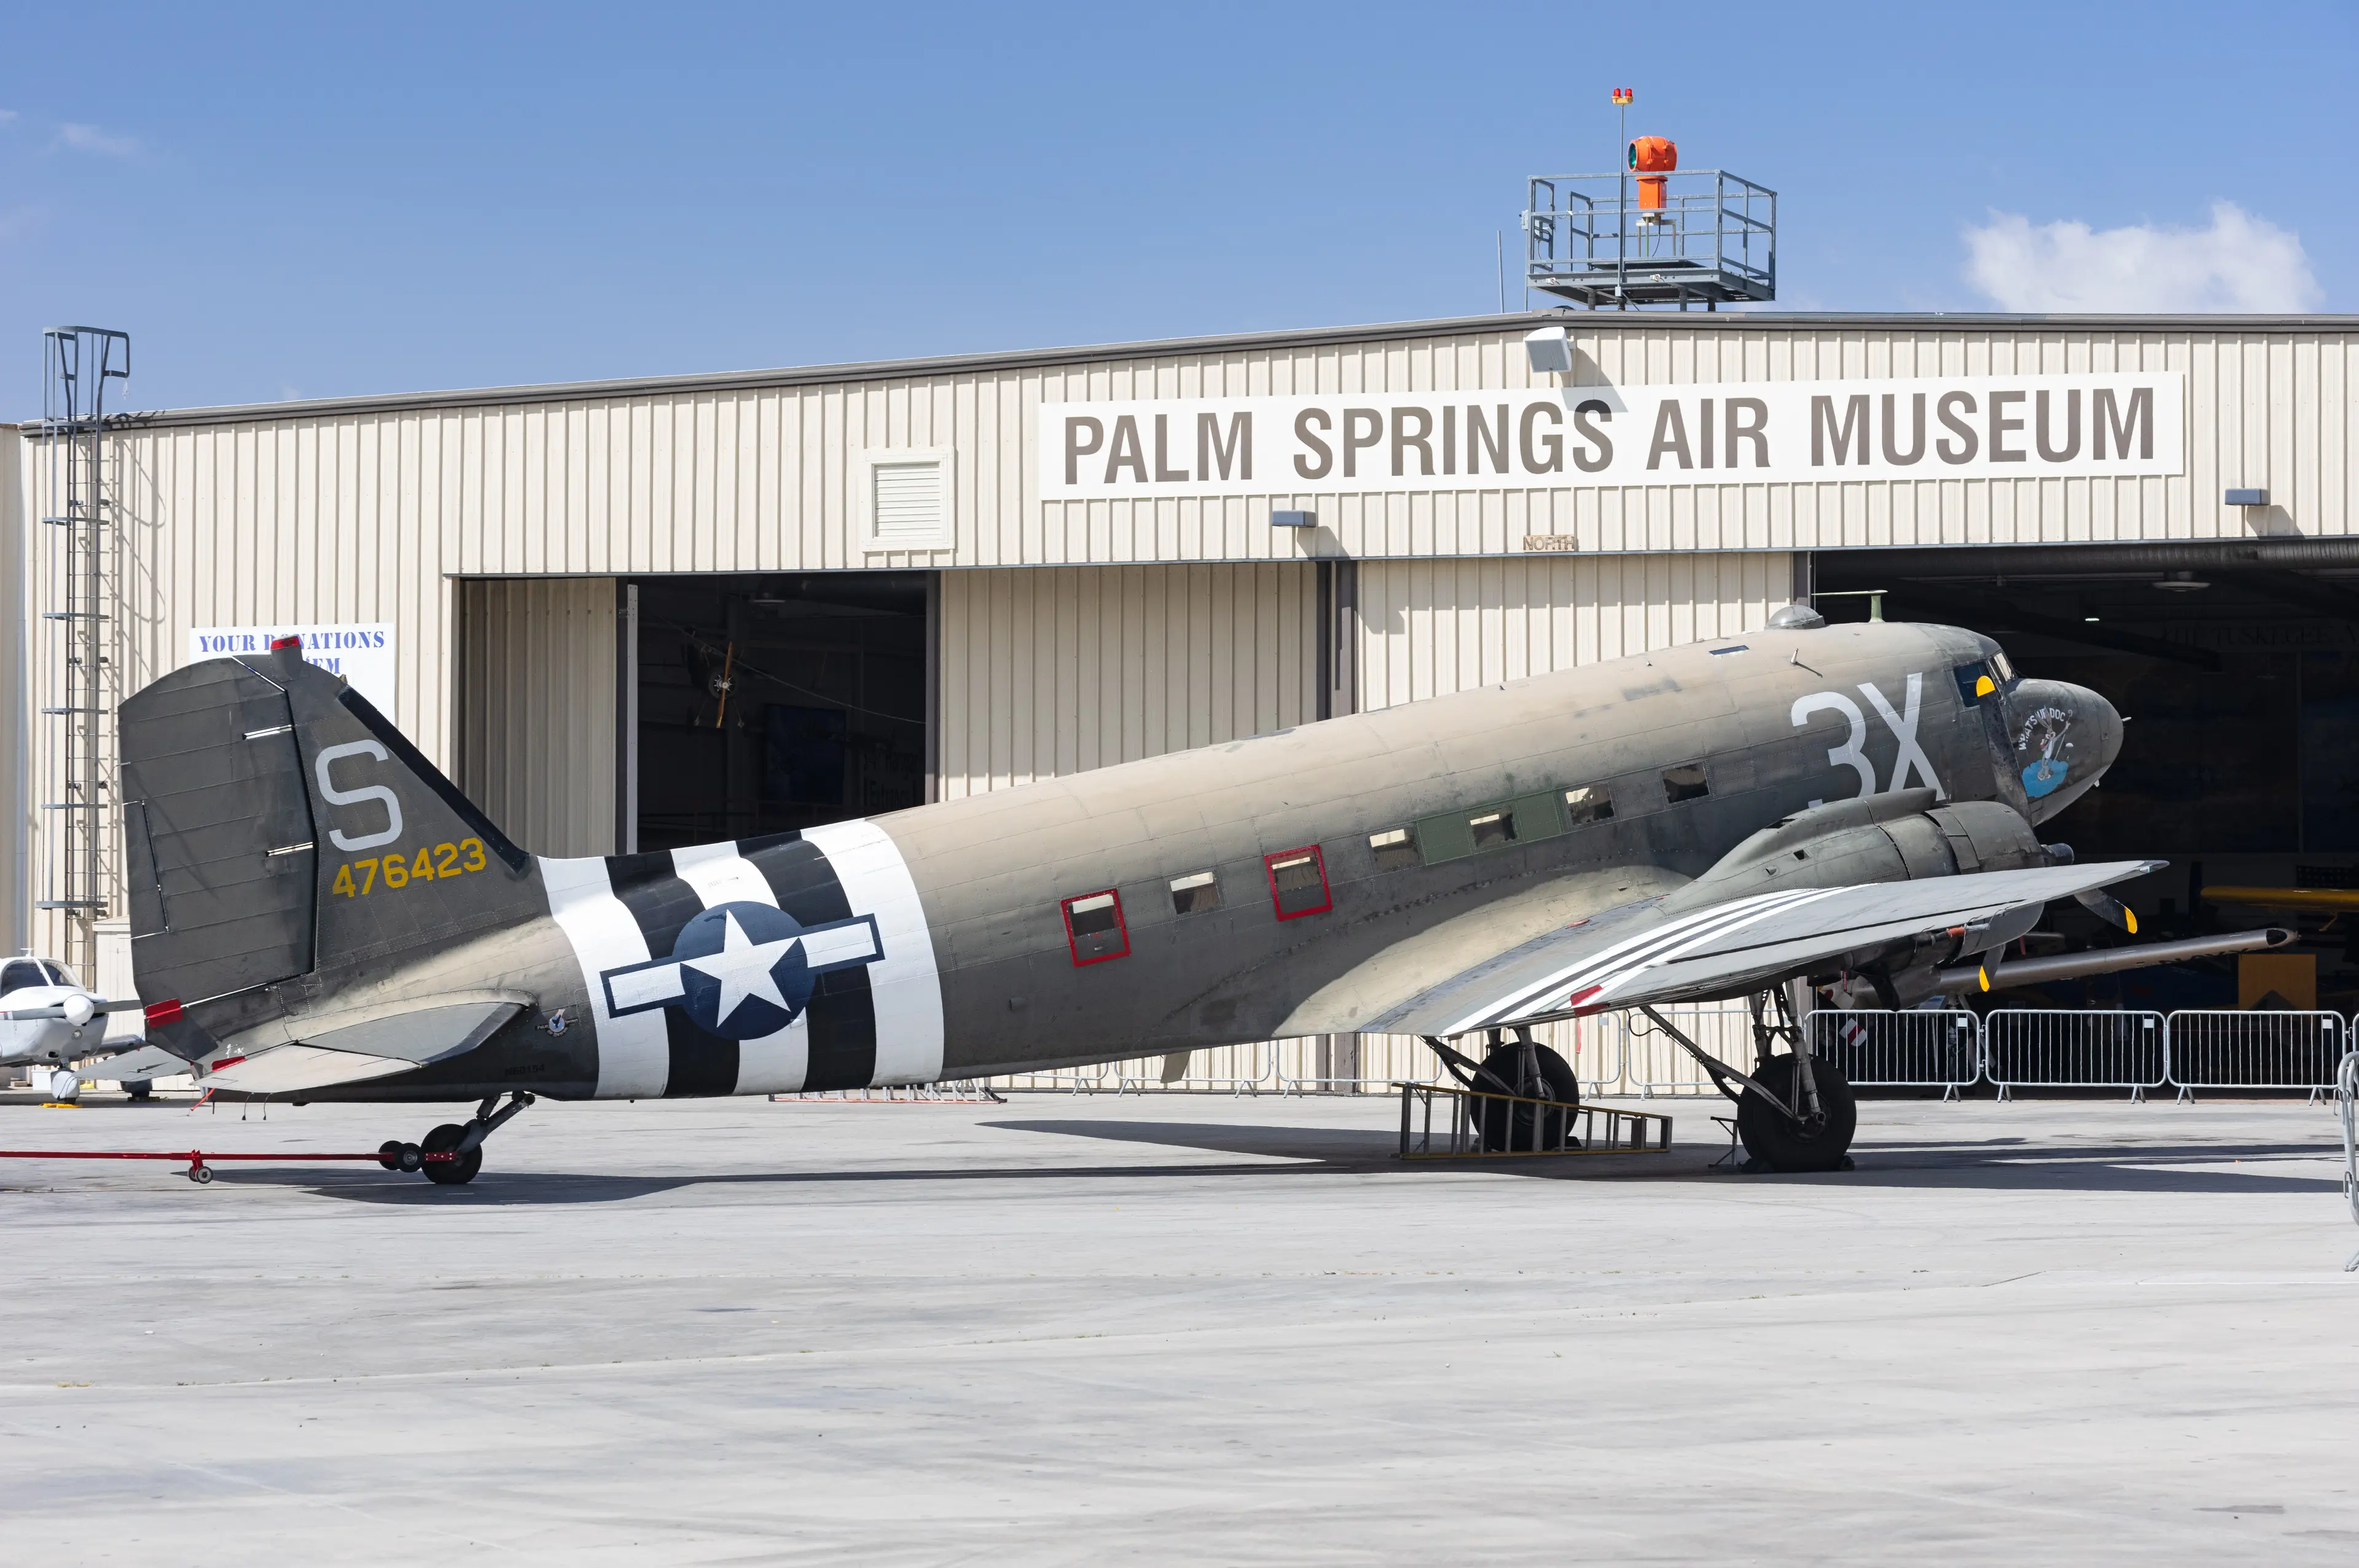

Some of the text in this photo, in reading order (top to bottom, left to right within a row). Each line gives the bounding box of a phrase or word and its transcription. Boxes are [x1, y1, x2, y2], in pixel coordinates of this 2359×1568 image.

[1065, 387, 2154, 485] PALM SPRINGS AIR MUSEUM
[1523, 536, 1575, 551] NORTH
[199, 631, 385, 652] YOUR DNATIONS
[1791, 672, 1947, 809] 3X
[315, 739, 403, 852] S
[332, 837, 487, 897] 476423
